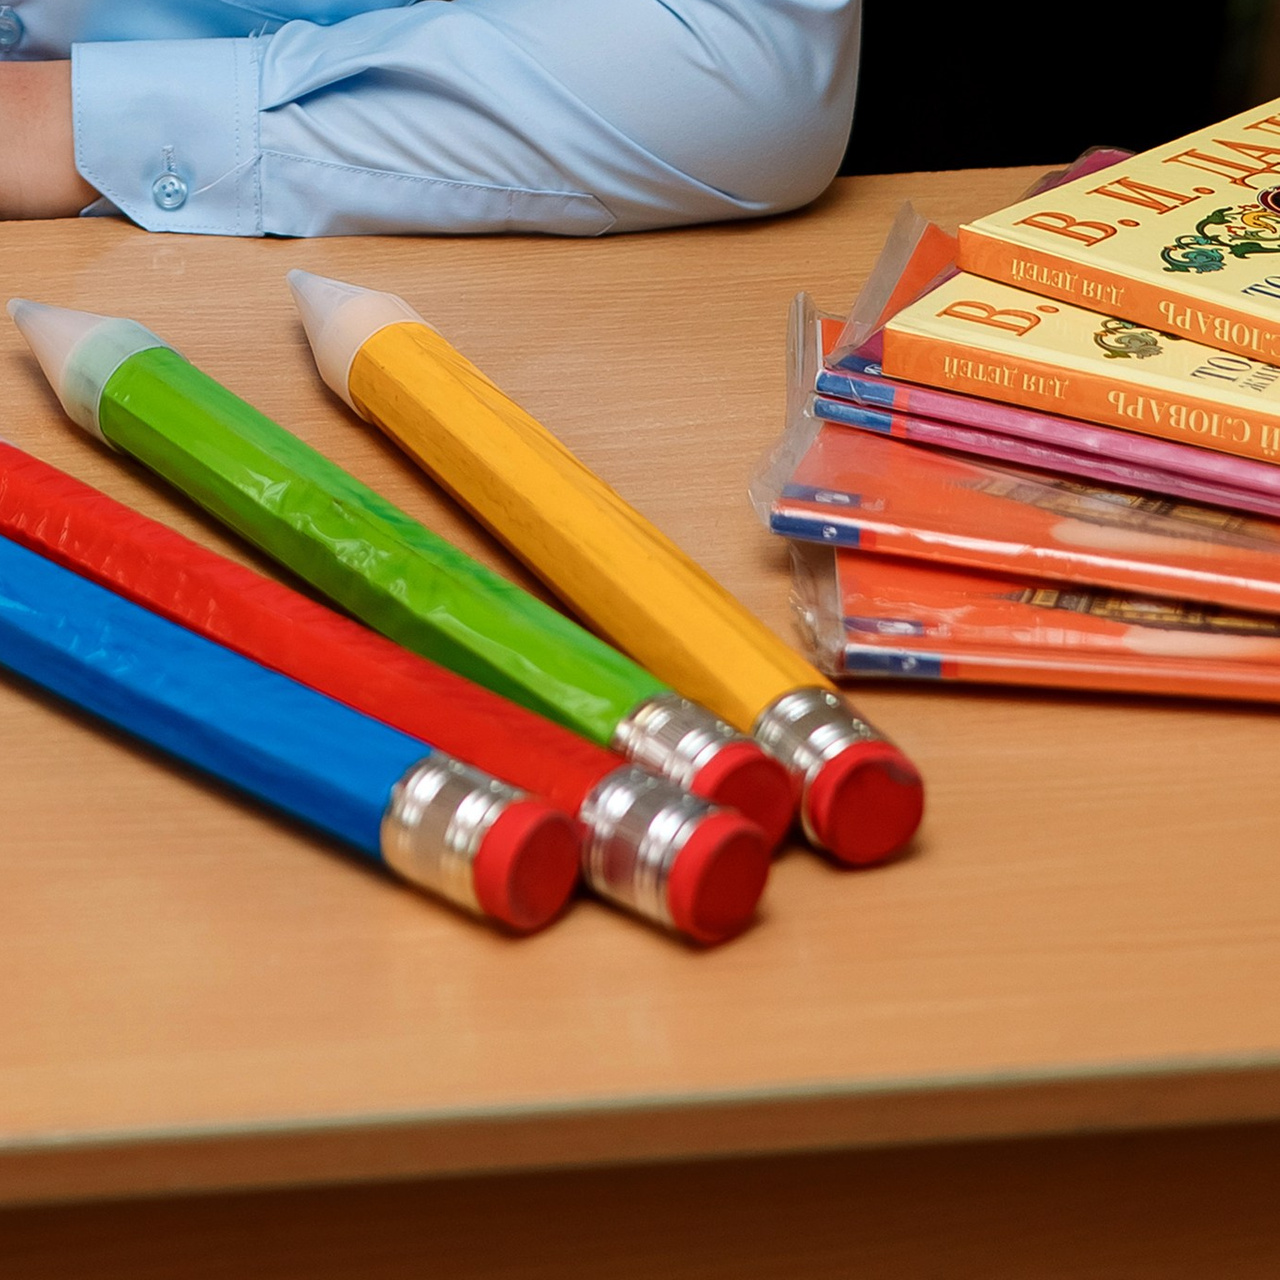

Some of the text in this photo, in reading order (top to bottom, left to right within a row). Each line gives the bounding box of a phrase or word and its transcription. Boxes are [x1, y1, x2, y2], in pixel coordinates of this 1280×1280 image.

[1162, 113, 1280, 190] ДА
[1011, 258, 1078, 292] ДЕТЕЙ
[1083, 279, 1124, 307] ДЛЯ
[936, 300, 1060, 338] В.
[943, 356, 1020, 390] ДЕТЕЙ
[1022, 372, 1069, 400] ДЛЯ
[1190, 357, 1252, 382] ТО
[1107, 390, 1251, 441] СЛОВАРЬ
